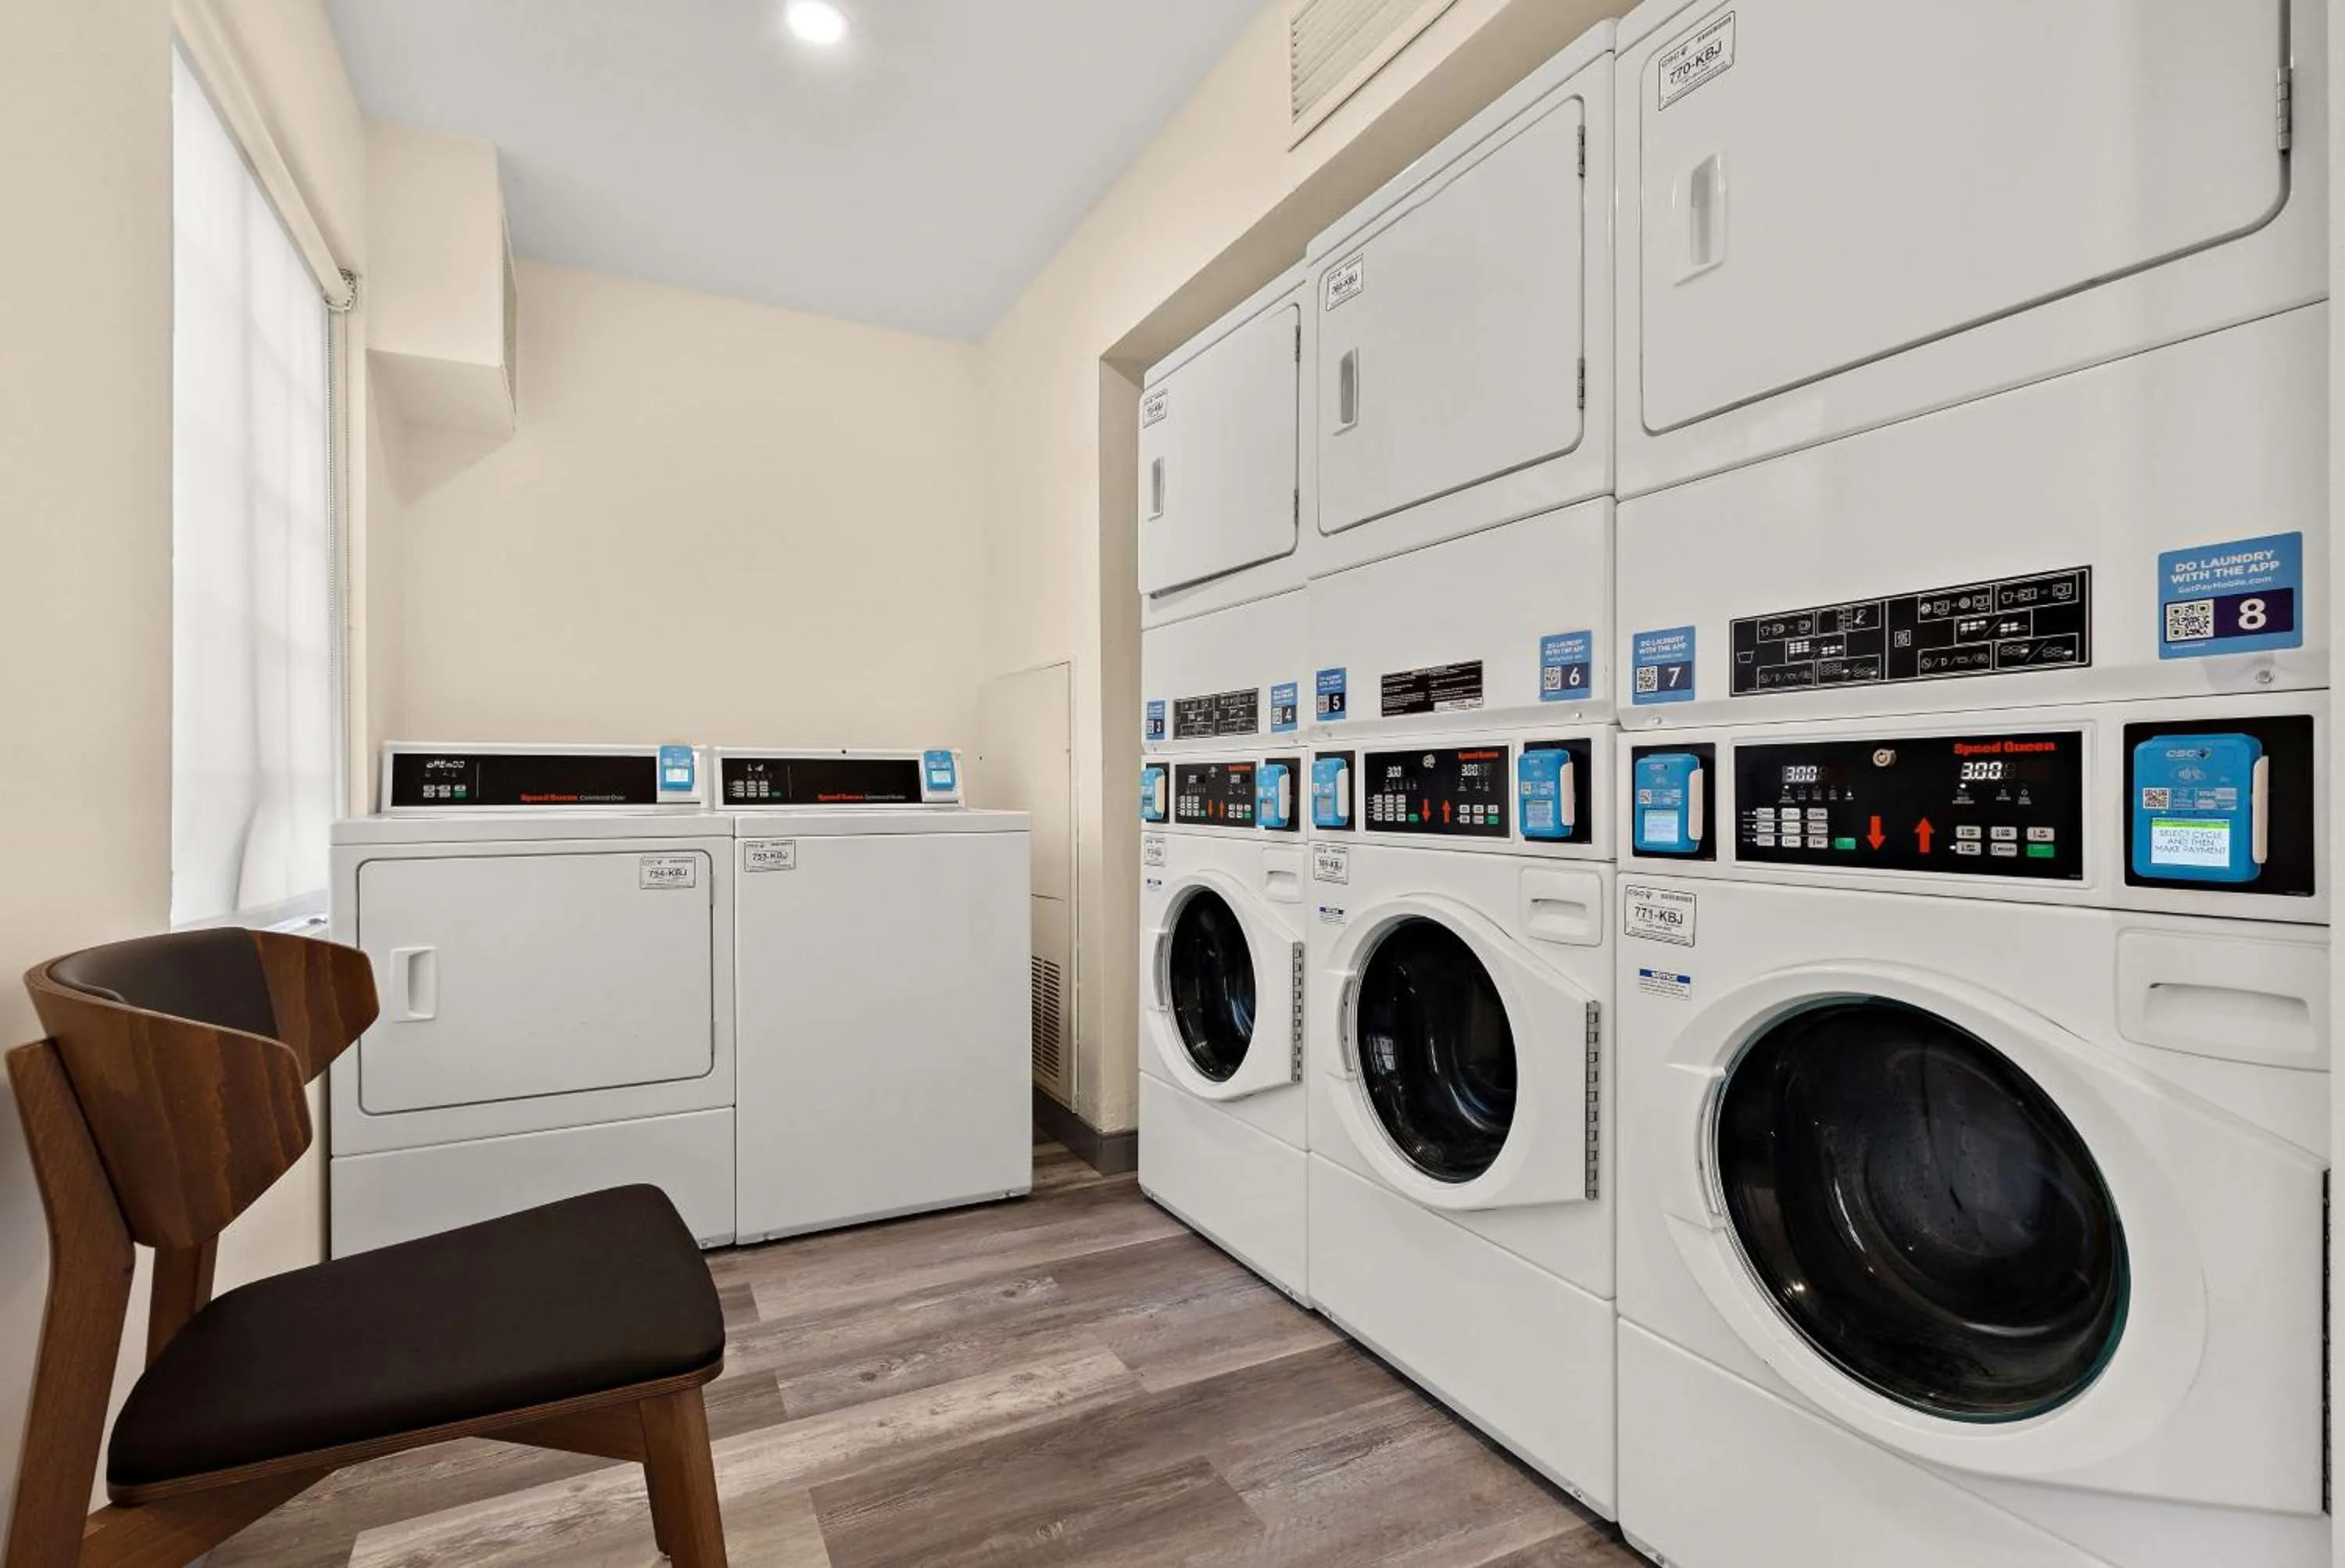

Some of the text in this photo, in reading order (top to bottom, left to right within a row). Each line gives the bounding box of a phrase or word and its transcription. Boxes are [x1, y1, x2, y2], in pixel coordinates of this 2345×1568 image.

[1669, 40, 1722, 84] 770-KBJ
[2175, 550, 2275, 573] DO LAUNDRY
[2171, 560, 2280, 584] WITH THE APP
[2238, 598, 2267, 630] 8
[1569, 667, 1580, 686] 6
[1667, 667, 1681, 687] 7
[1333, 695, 1341, 711] 5
[1284, 707, 1292, 721] 4
[1954, 740, 2054, 756] Speed Queen
[2183, 846, 2227, 855] PAYMENT
[1634, 906, 1684, 925] 771-KBJ
